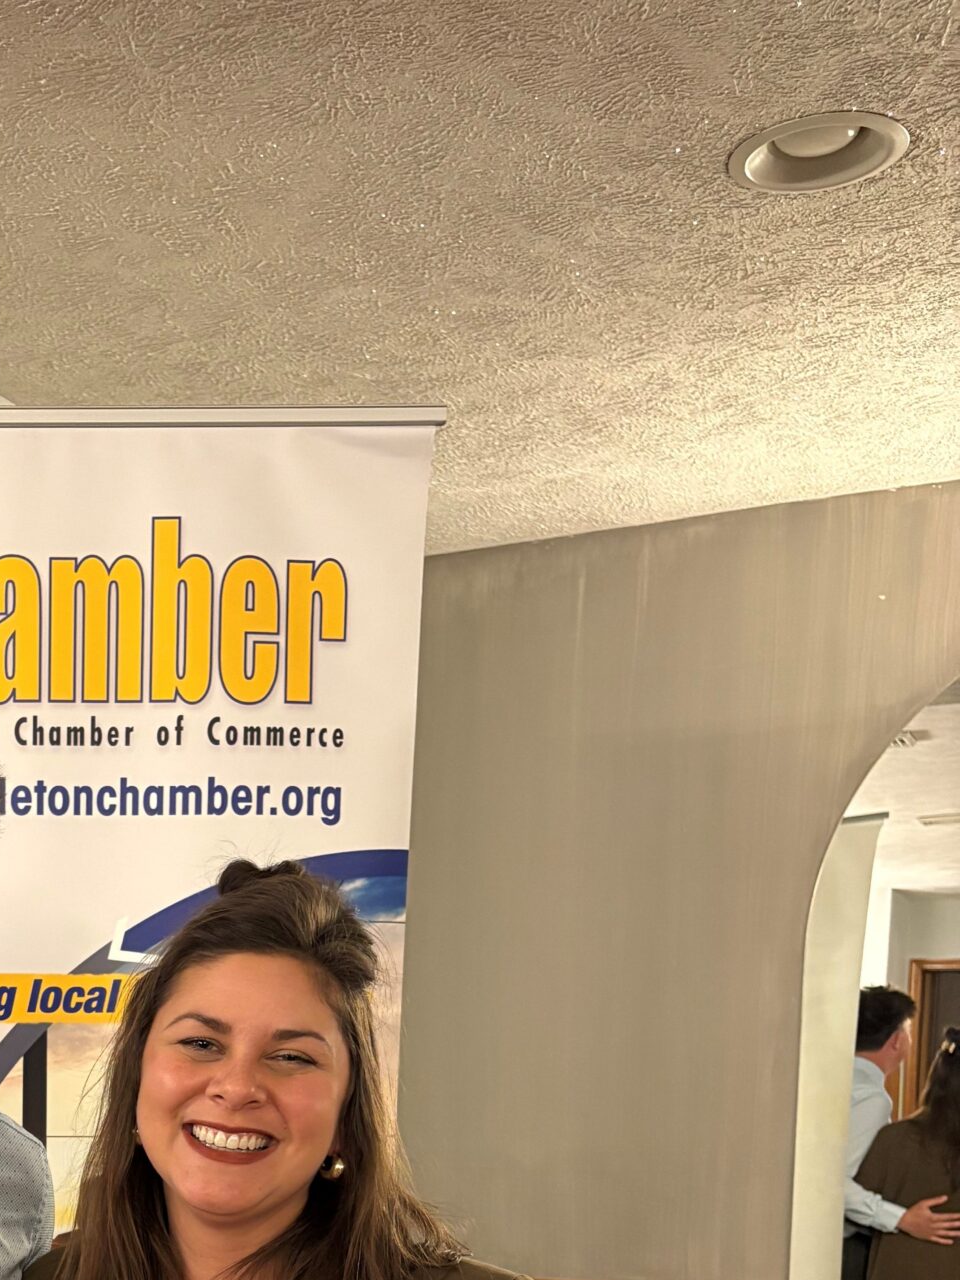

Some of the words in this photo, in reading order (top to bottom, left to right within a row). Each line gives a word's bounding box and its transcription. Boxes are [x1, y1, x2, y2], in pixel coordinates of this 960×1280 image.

[14, 715, 134, 747] Chamber
[156, 715, 184, 747] of
[207, 716, 345, 748] Commerce
[27, 978, 122, 1014] local
